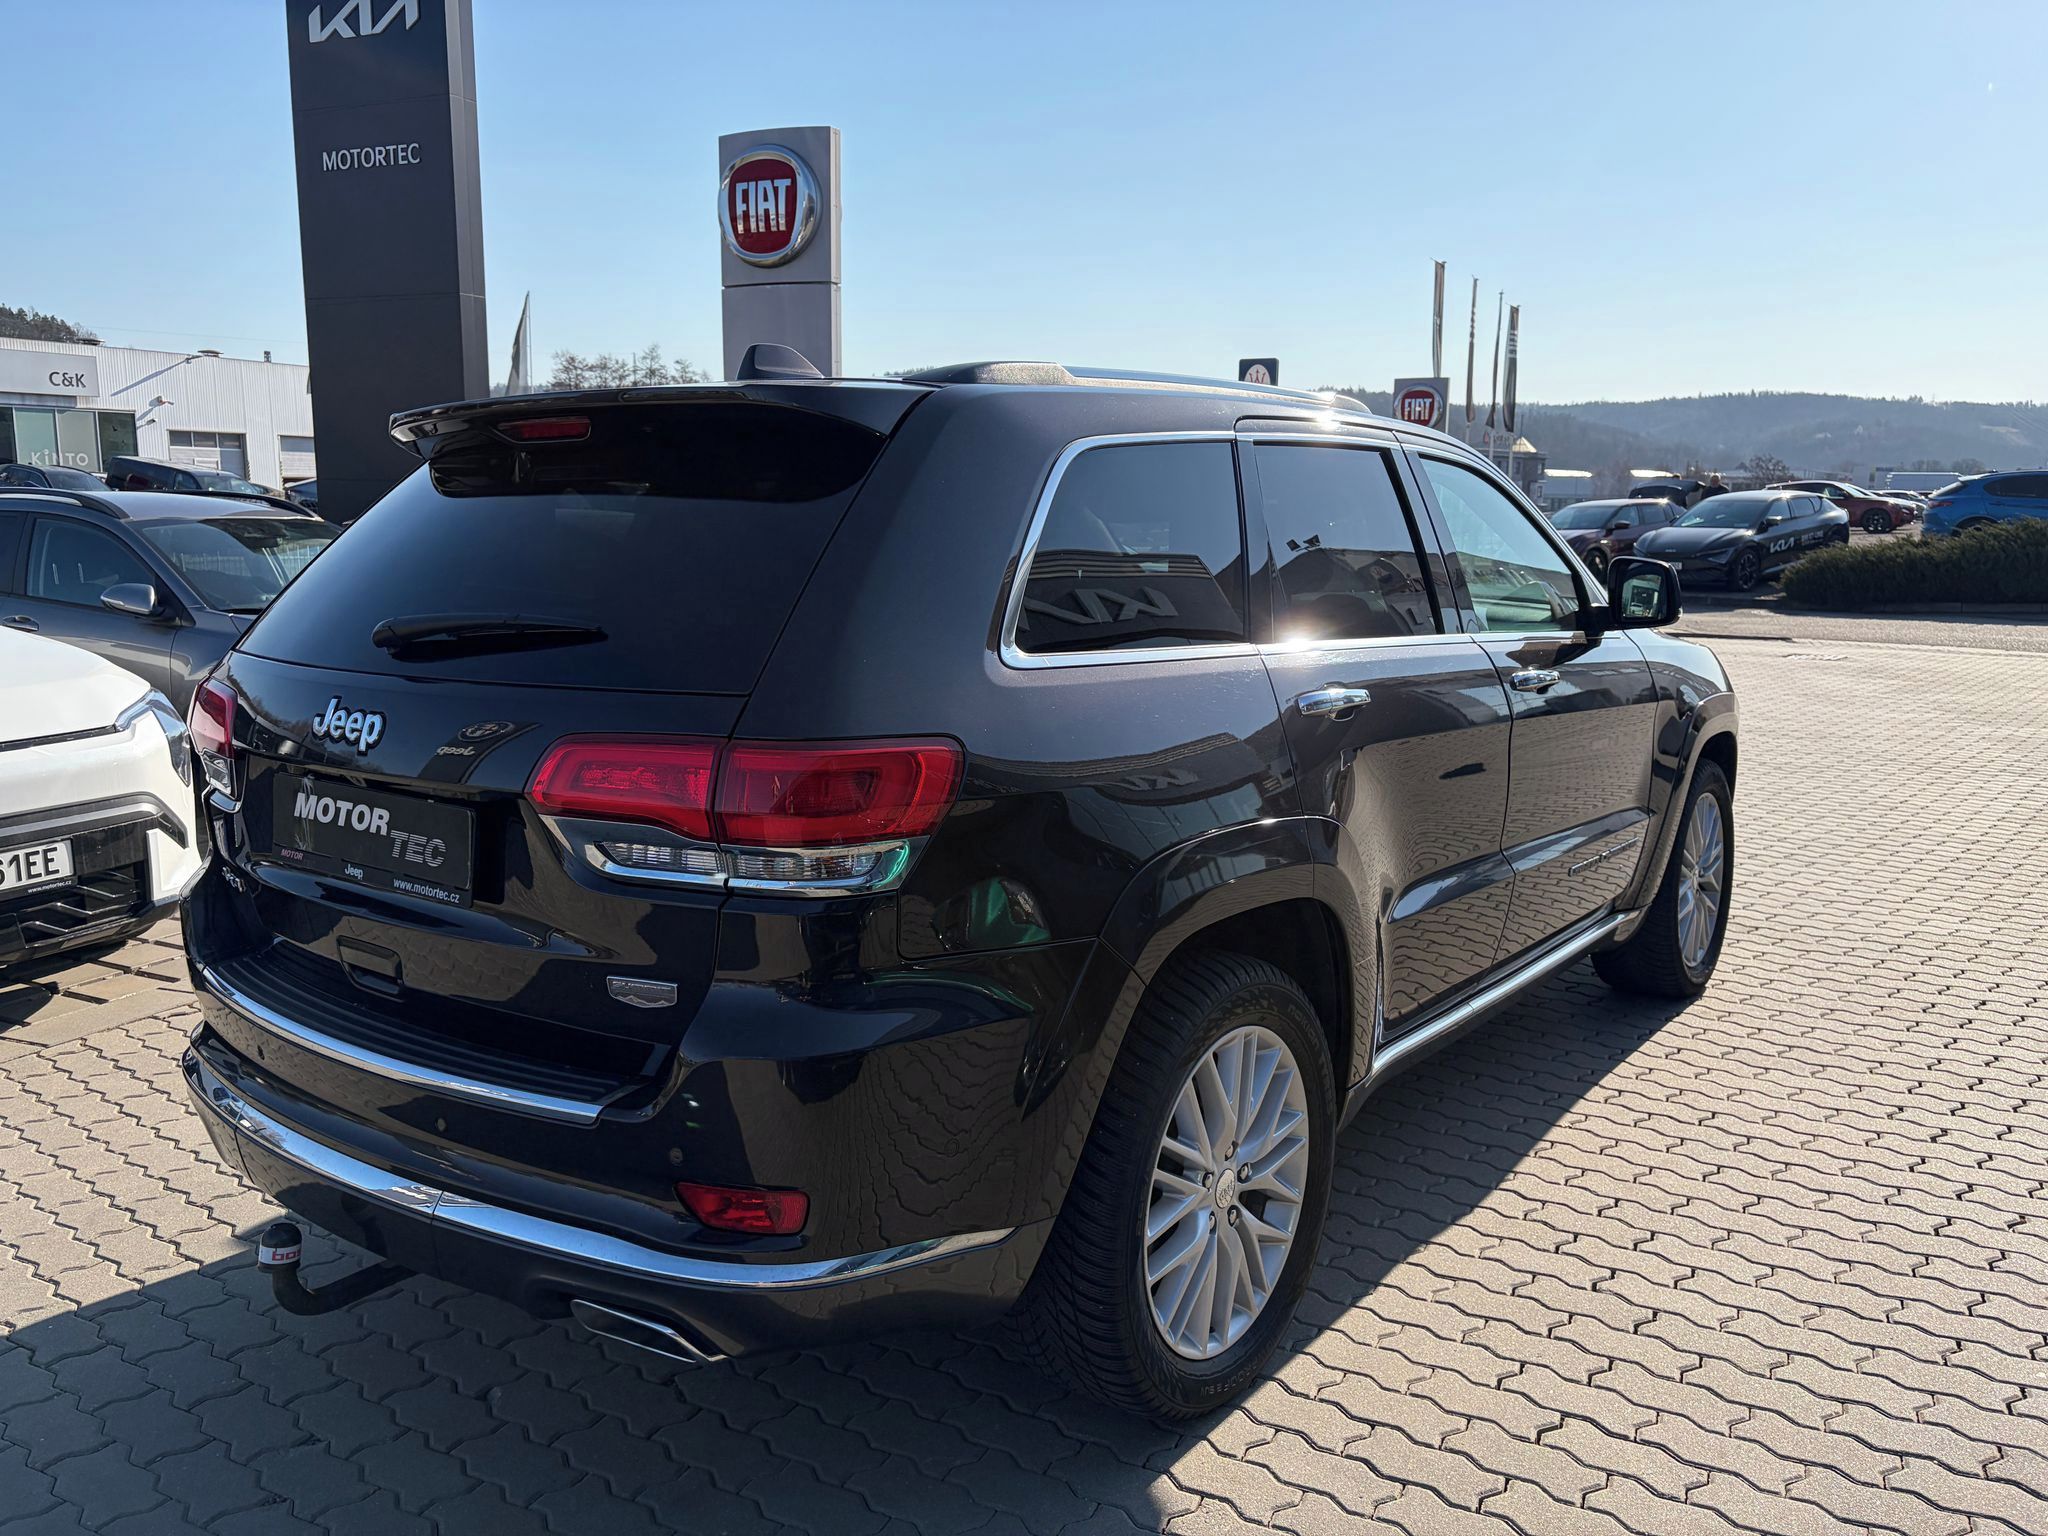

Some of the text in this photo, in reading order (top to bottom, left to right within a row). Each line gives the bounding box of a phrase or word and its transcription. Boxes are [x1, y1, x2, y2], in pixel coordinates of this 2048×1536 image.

[322, 143, 420, 171] MOTORTEC
[735, 178, 792, 234] FIAT
[48, 371, 86, 388] C&K
[1404, 398, 1433, 421] FIAT
[312, 696, 386, 756] Jeep
[294, 792, 390, 835] MOTOR
[390, 829, 446, 867] TEC
[28, 880, 72, 894] www.motortec.cz
[281, 848, 460, 903] MOTOR Jeep www.motortec.cz
